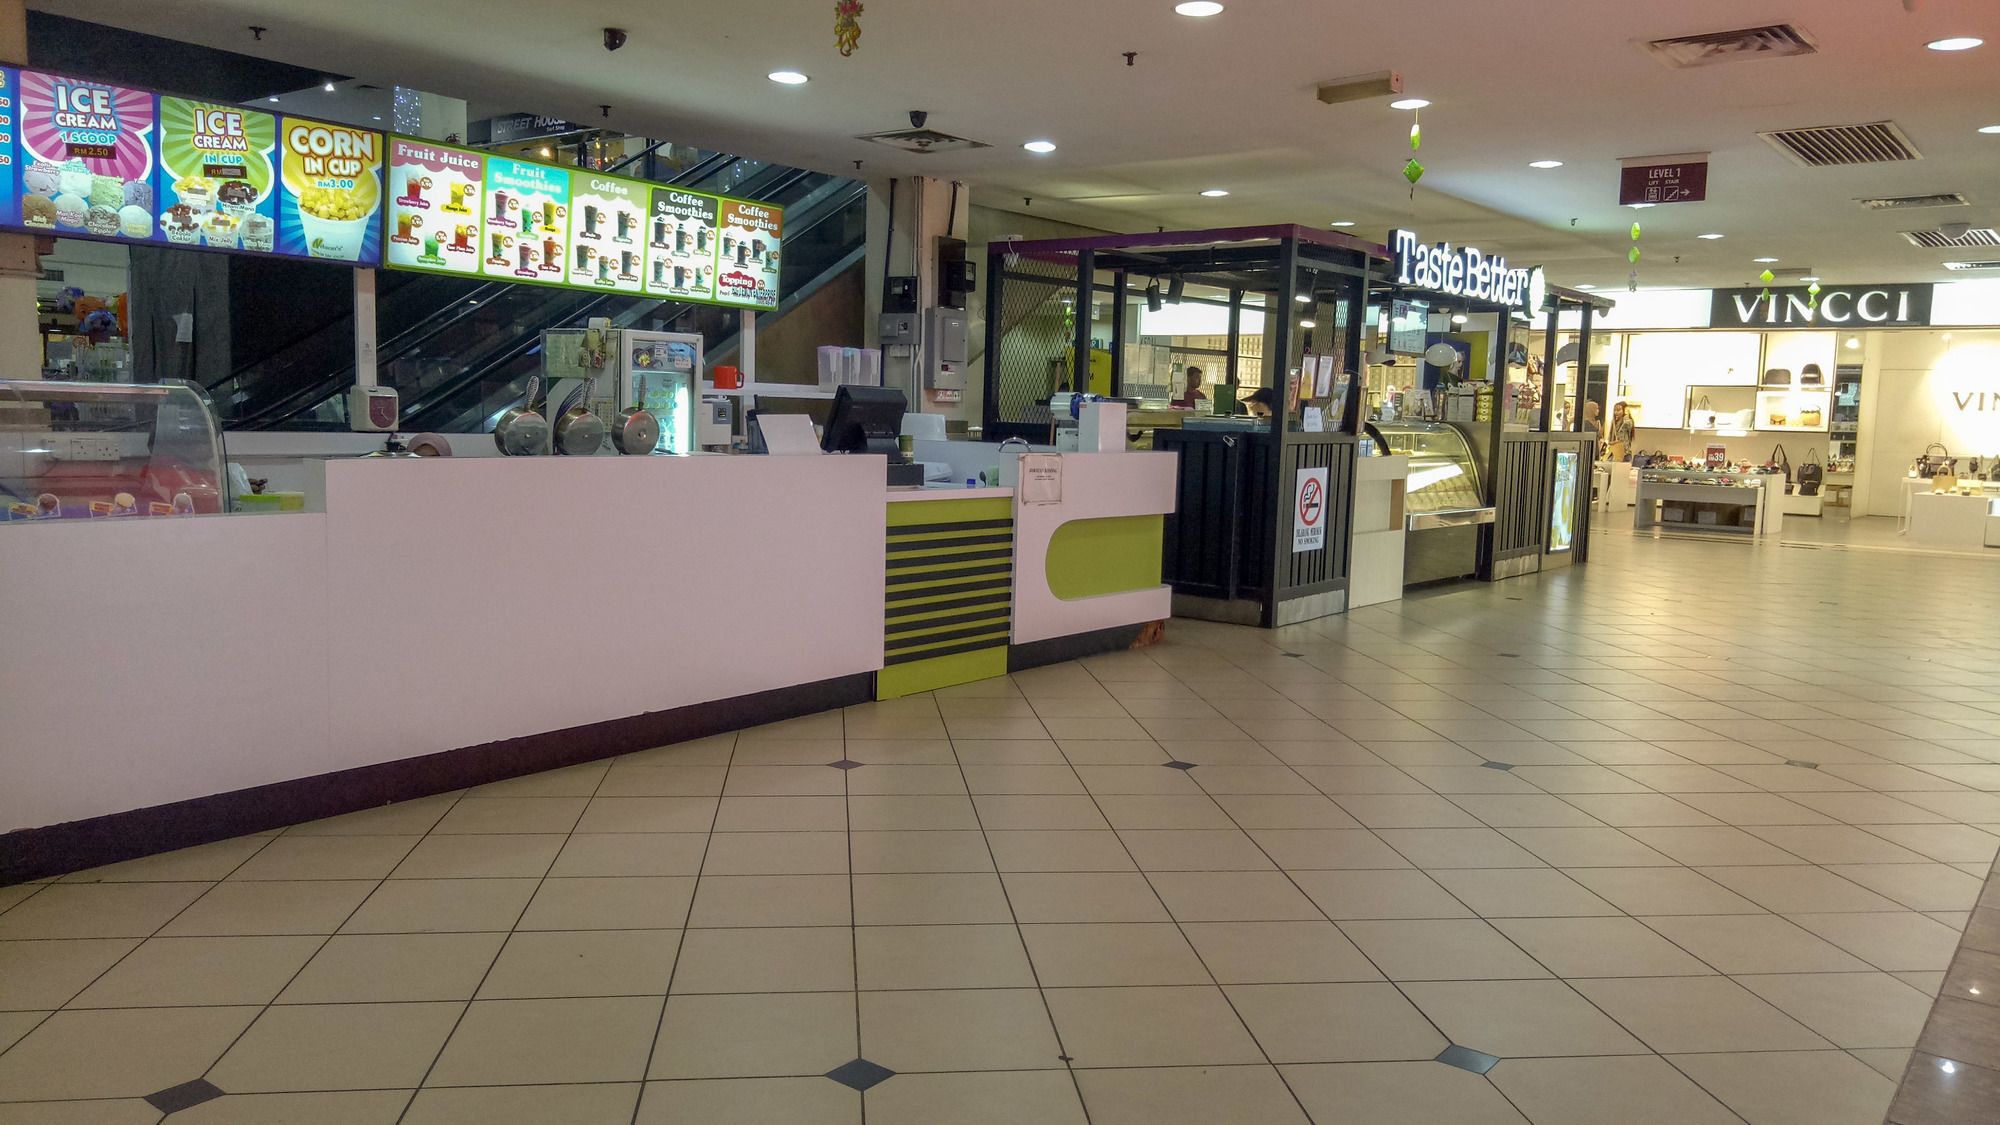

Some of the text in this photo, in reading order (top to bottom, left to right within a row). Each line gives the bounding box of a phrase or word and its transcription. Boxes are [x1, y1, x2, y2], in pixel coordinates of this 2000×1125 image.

[56, 85, 112, 115] ICE
[55, 112, 117, 130] CREAM
[195, 109, 243, 137] ICE
[60, 132, 117, 144] 1 SCOOP
[193, 135, 248, 151] CREAM
[289, 126, 375, 161] CORN
[204, 154, 242, 164] IN CUP
[398, 144, 479, 169] Fruit Juice
[303, 156, 363, 177] IN CUP
[512, 163, 545, 179] Fruit
[1649, 167, 1681, 179] LEVEL 1
[590, 179, 628, 195] Coffee
[669, 192, 704, 207] Coffee
[657, 201, 713, 220] Smoothies
[738, 204, 769, 218] Coffee
[727, 213, 778, 231] Smoothies
[721, 274, 753, 287] Topping
[1732, 290, 1909, 323] VINCCI
